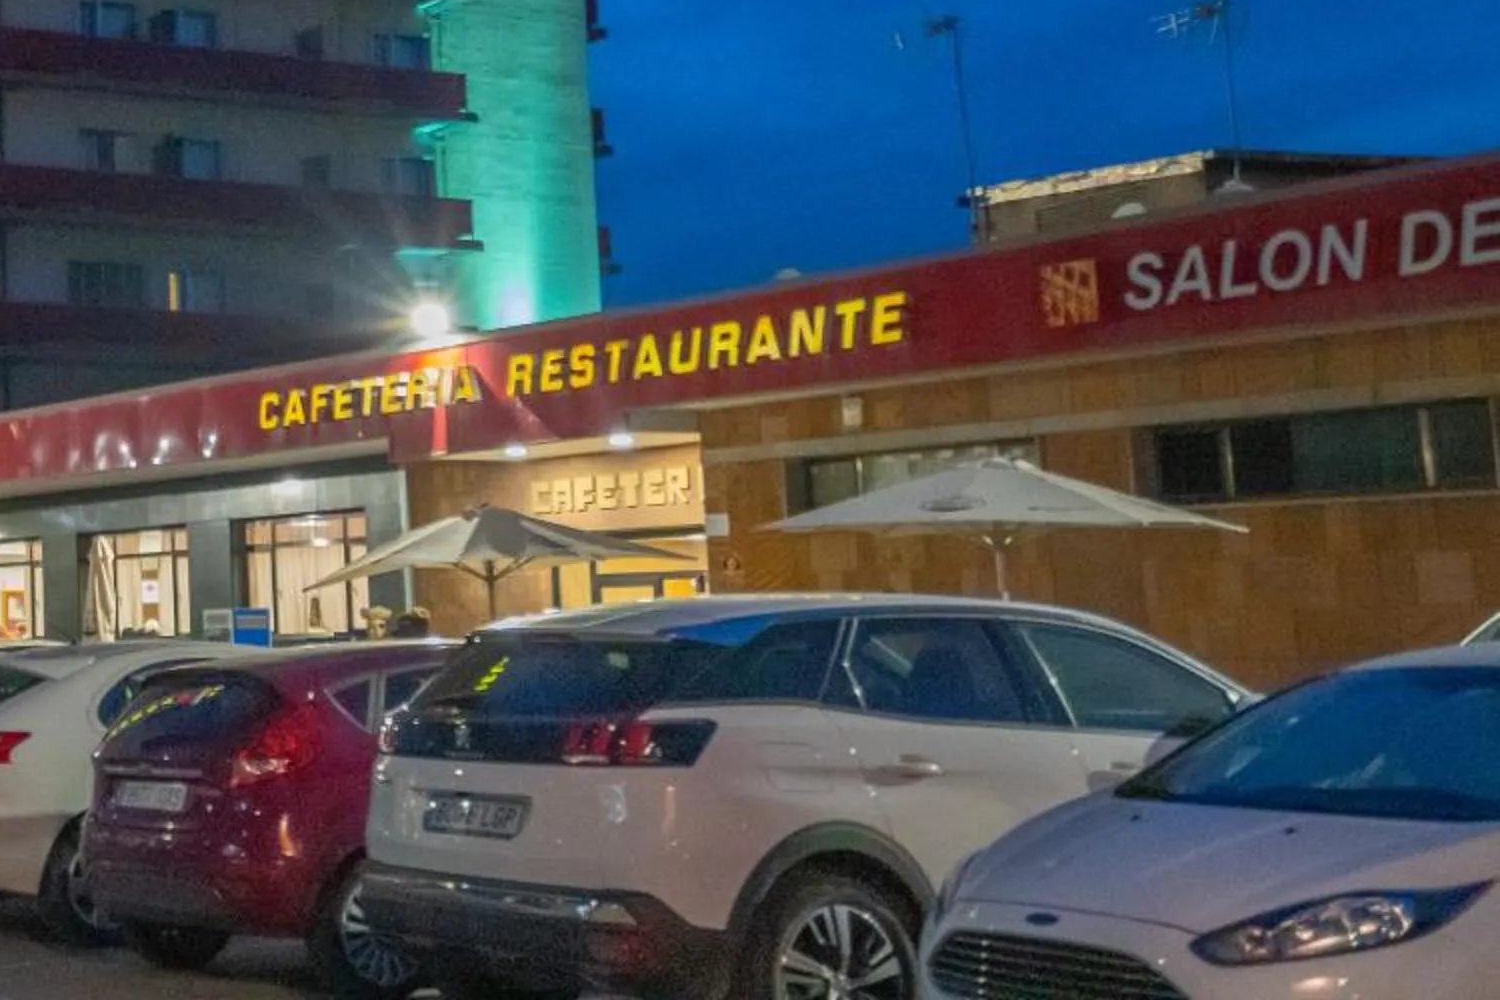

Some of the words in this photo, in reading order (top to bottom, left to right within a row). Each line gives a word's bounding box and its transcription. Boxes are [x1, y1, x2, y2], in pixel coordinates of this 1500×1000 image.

[1123, 217, 1368, 310] SALON
[1398, 197, 1500, 277] DE
[259, 366, 477, 430] CAFETERIA
[506, 291, 907, 398] RESTAURANTE
[531, 466, 689, 513] CAFETER
